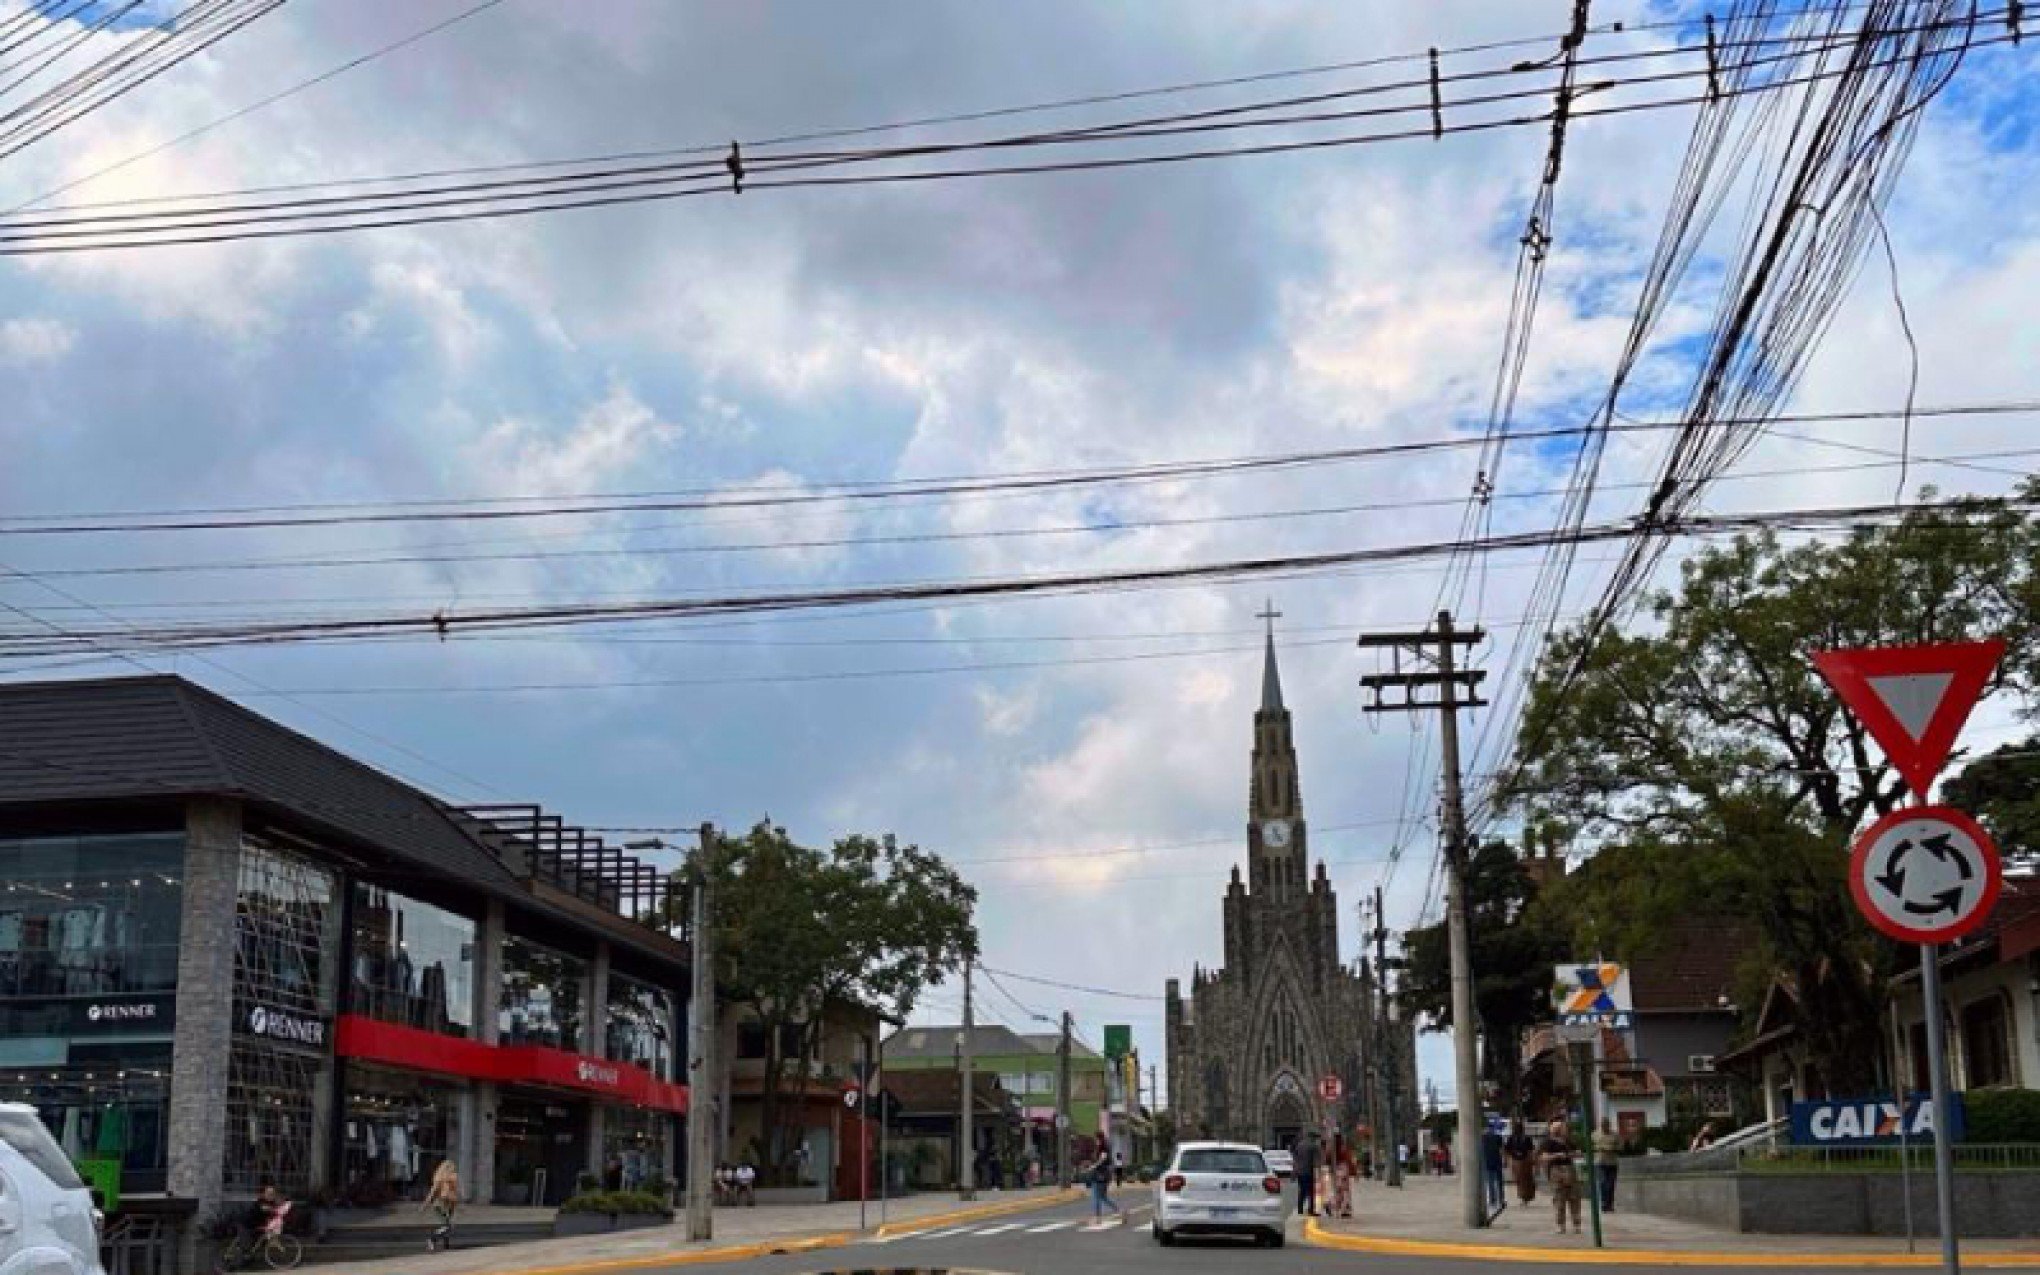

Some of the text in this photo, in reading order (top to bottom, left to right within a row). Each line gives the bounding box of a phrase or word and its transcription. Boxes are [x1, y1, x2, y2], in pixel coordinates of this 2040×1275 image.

[103, 1004, 156, 1017] RENNER
[268, 1010, 324, 1045] RENNER
[1809, 1100, 1938, 1140] CAIXA
